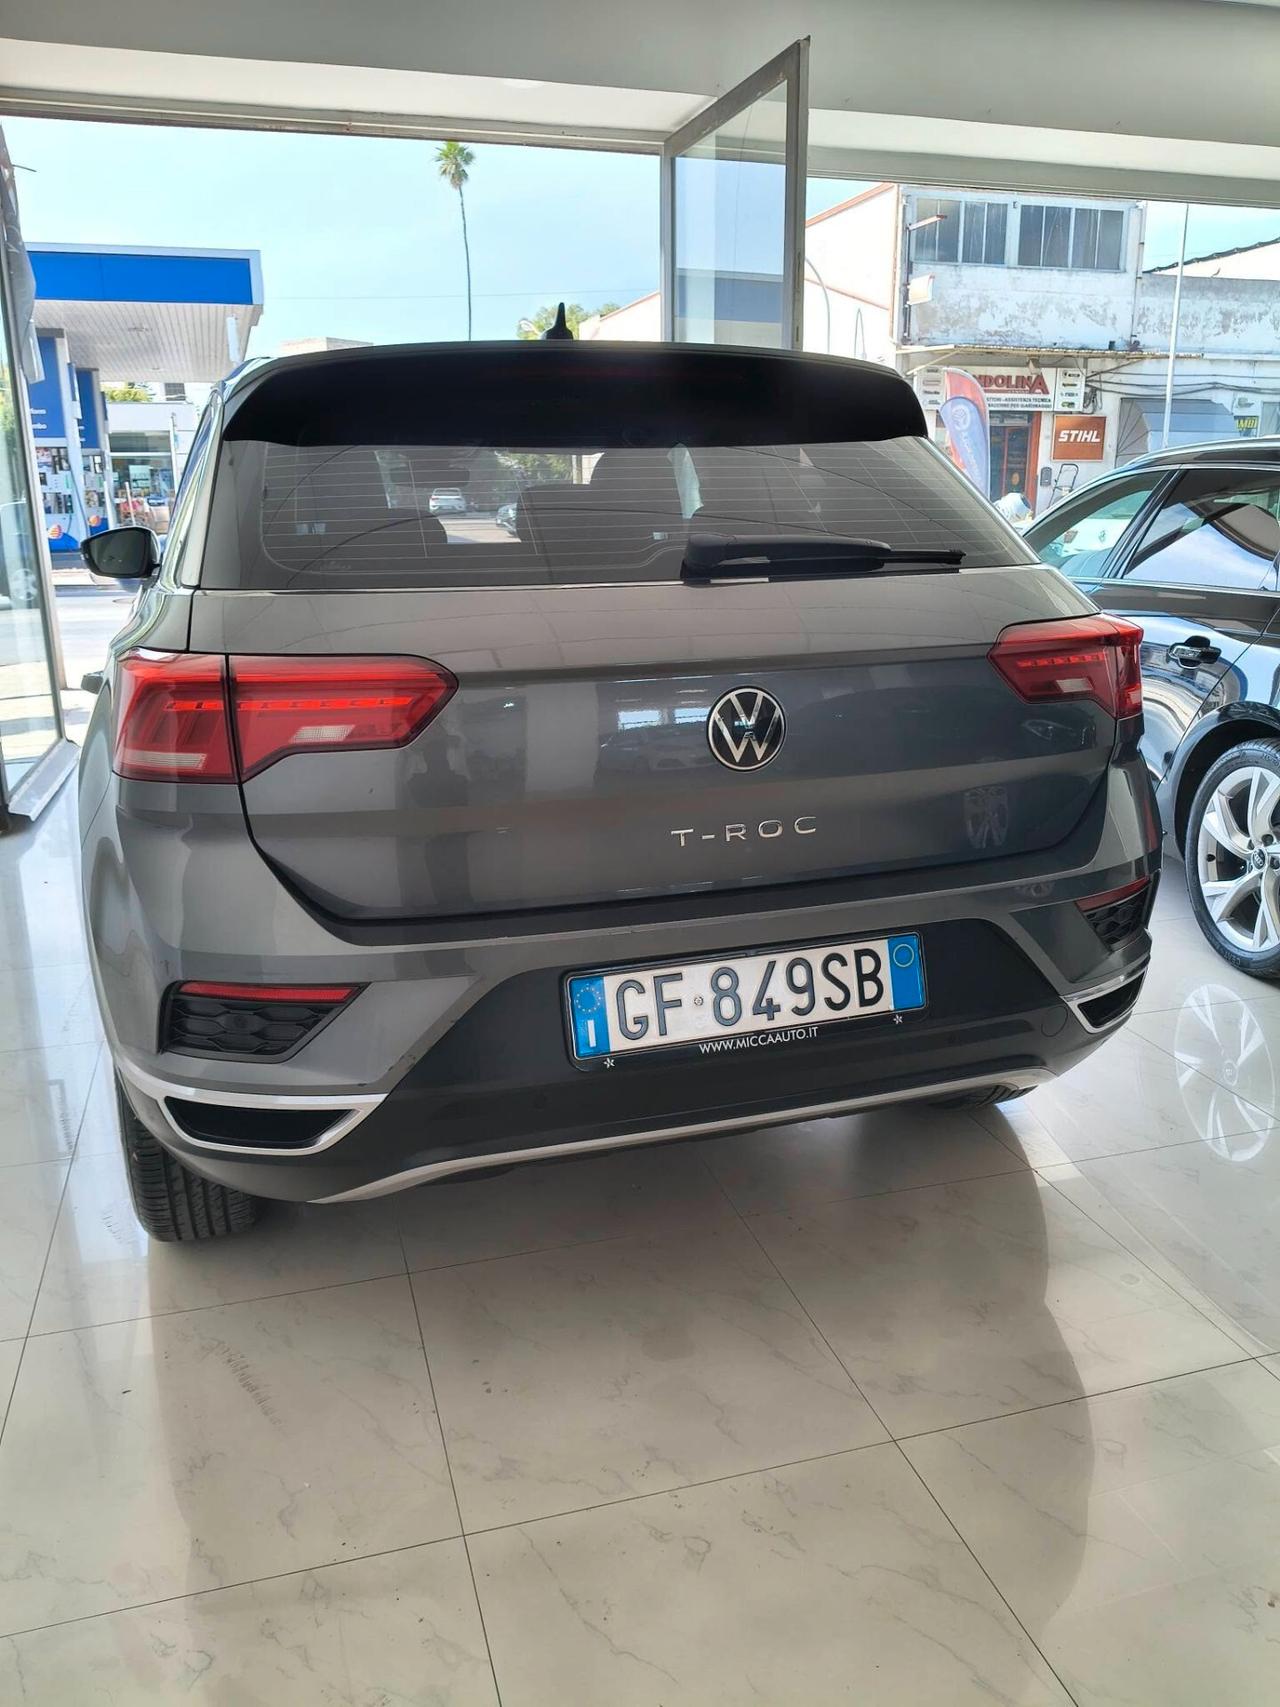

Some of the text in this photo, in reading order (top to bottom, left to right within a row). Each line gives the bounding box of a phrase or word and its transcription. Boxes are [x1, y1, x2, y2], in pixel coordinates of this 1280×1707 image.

[973, 372, 1050, 394] NDOLINA
[1058, 430, 1101, 443] STIHL
[671, 816, 817, 847] T-ROC
[615, 948, 885, 1040] GF 849SB
[587, 1019, 597, 1048] I
[698, 1026, 819, 1054] WWW.MICCAAUTO.IT
